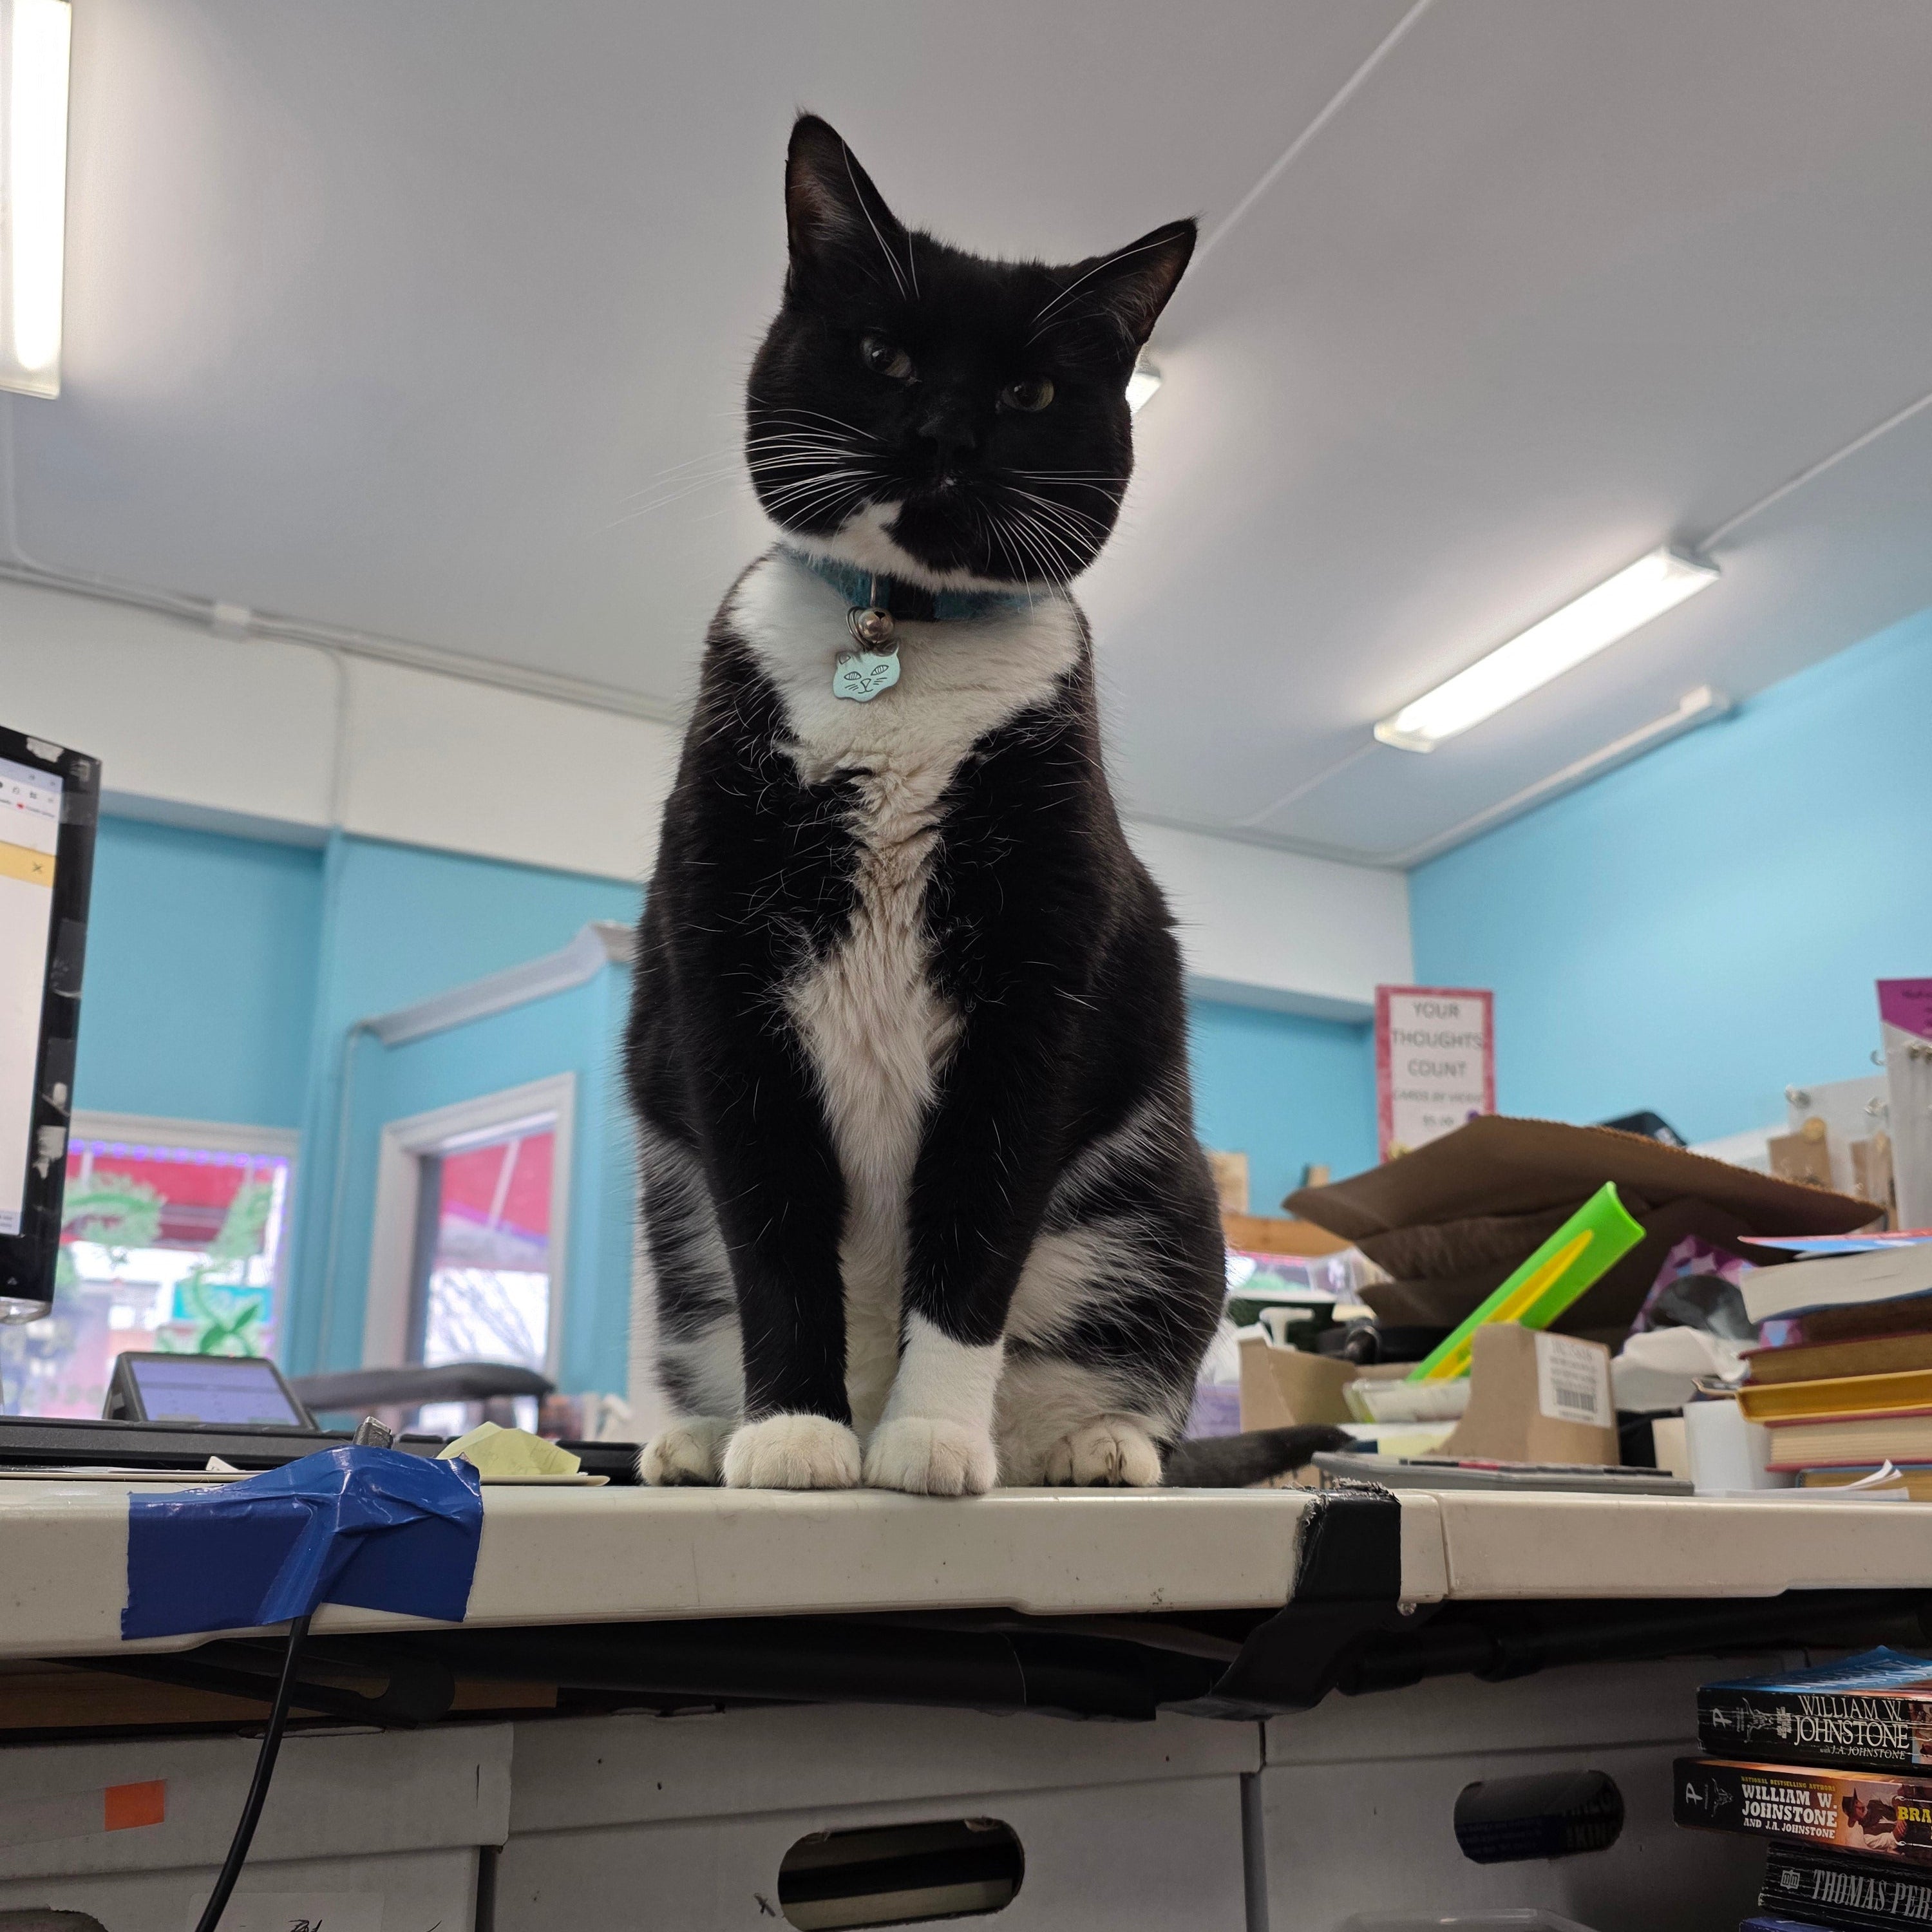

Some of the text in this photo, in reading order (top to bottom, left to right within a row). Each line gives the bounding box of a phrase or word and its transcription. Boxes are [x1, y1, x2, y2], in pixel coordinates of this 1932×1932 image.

[1413, 1002, 1460, 1019] YOUR
[1392, 1030, 1483, 1050] THOUGHTS
[1406, 1059, 1467, 1077] COUNT
[1797, 1695, 1902, 1721] WILLIAM W.
[1794, 1716, 1909, 1748] JOHNSTONE
[1831, 1746, 1846, 1755] J.A.
[1847, 1746, 1906, 1760] JOHNSTONE
[1741, 1776, 1835, 1792] NATIONAL BESTSELLING AUTHORS
[1741, 1784, 1837, 1809] WILLIAM W.
[1741, 1800, 1837, 1828] JOHNSTONE
[1743, 1817, 1835, 1839] AND J.A. JOHNSTONE
[1812, 1869, 1887, 1911] THOMAS
[1890, 1882, 1932, 1921] PER
